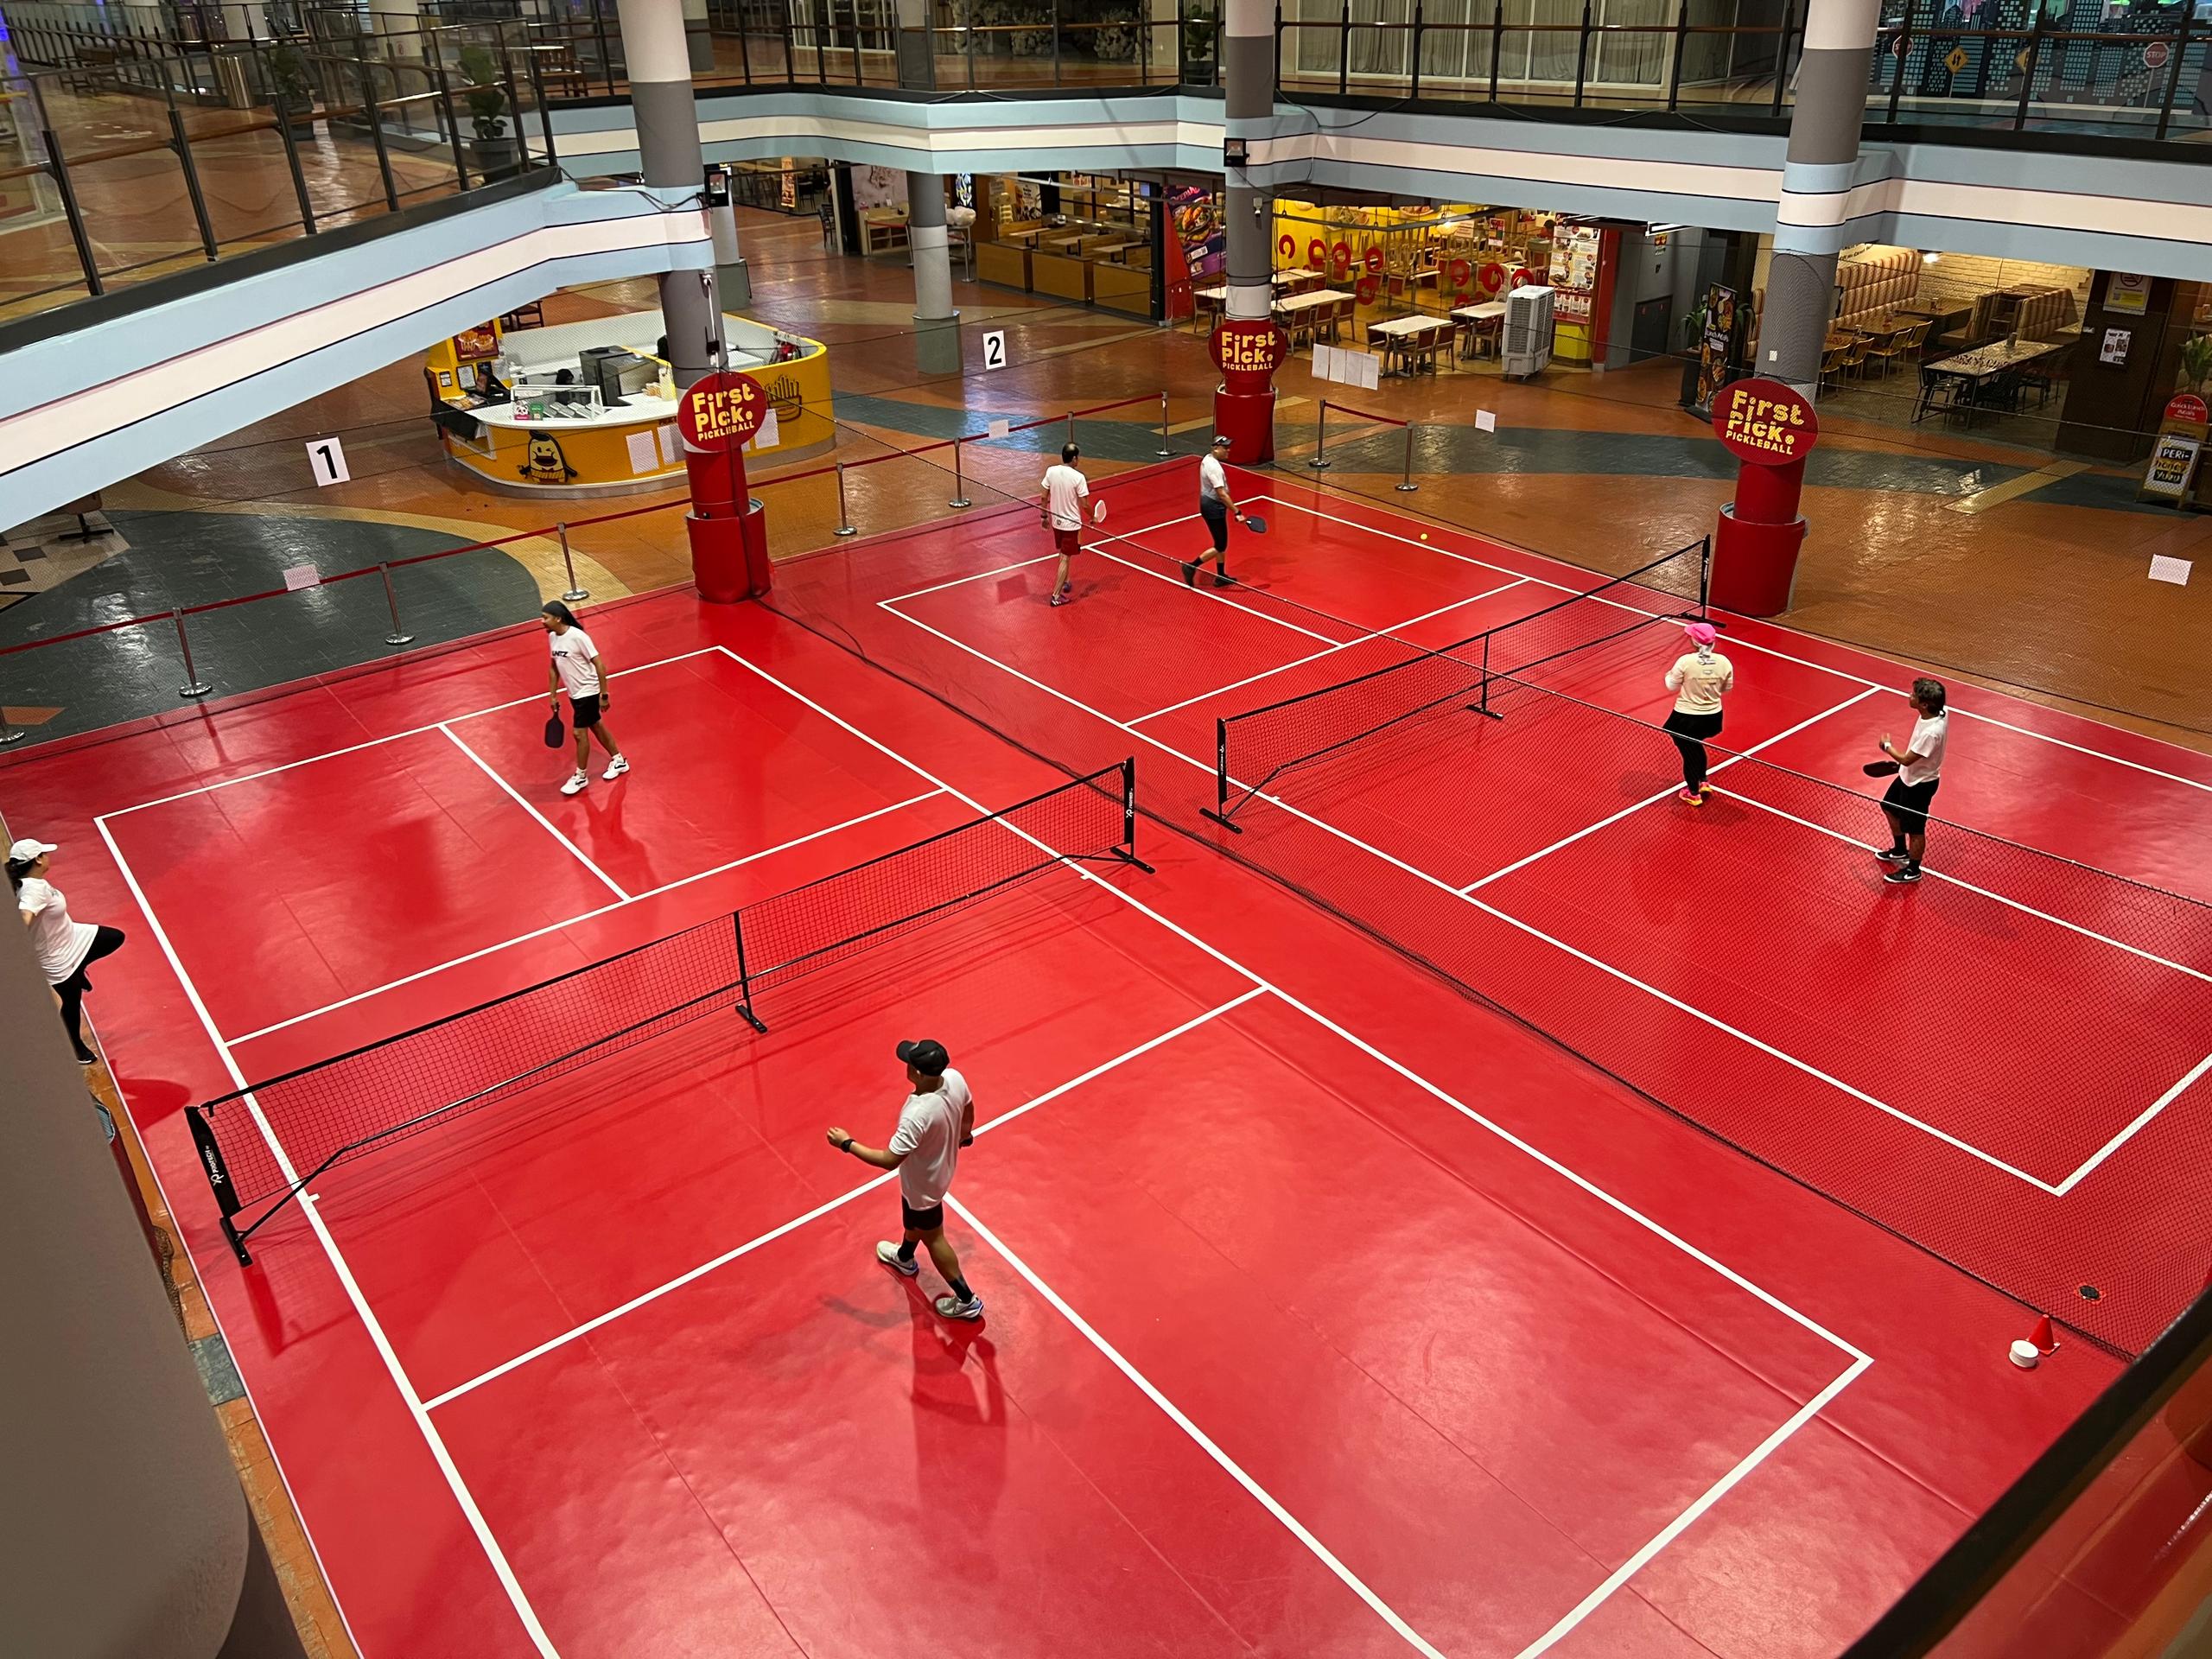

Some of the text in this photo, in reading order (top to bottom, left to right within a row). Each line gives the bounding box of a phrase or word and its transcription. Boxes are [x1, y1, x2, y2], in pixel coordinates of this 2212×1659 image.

[988, 336, 1002, 365] 2
[1221, 331, 1275, 349] First
[1222, 361, 1273, 372] PICKLEBALL
[692, 383, 755, 413] First
[1732, 390, 1804, 425] First
[697, 421, 755, 442] PICKLEBALL
[1725, 430, 1793, 454] PICKLEBALL
[316, 445, 338, 480] 1
